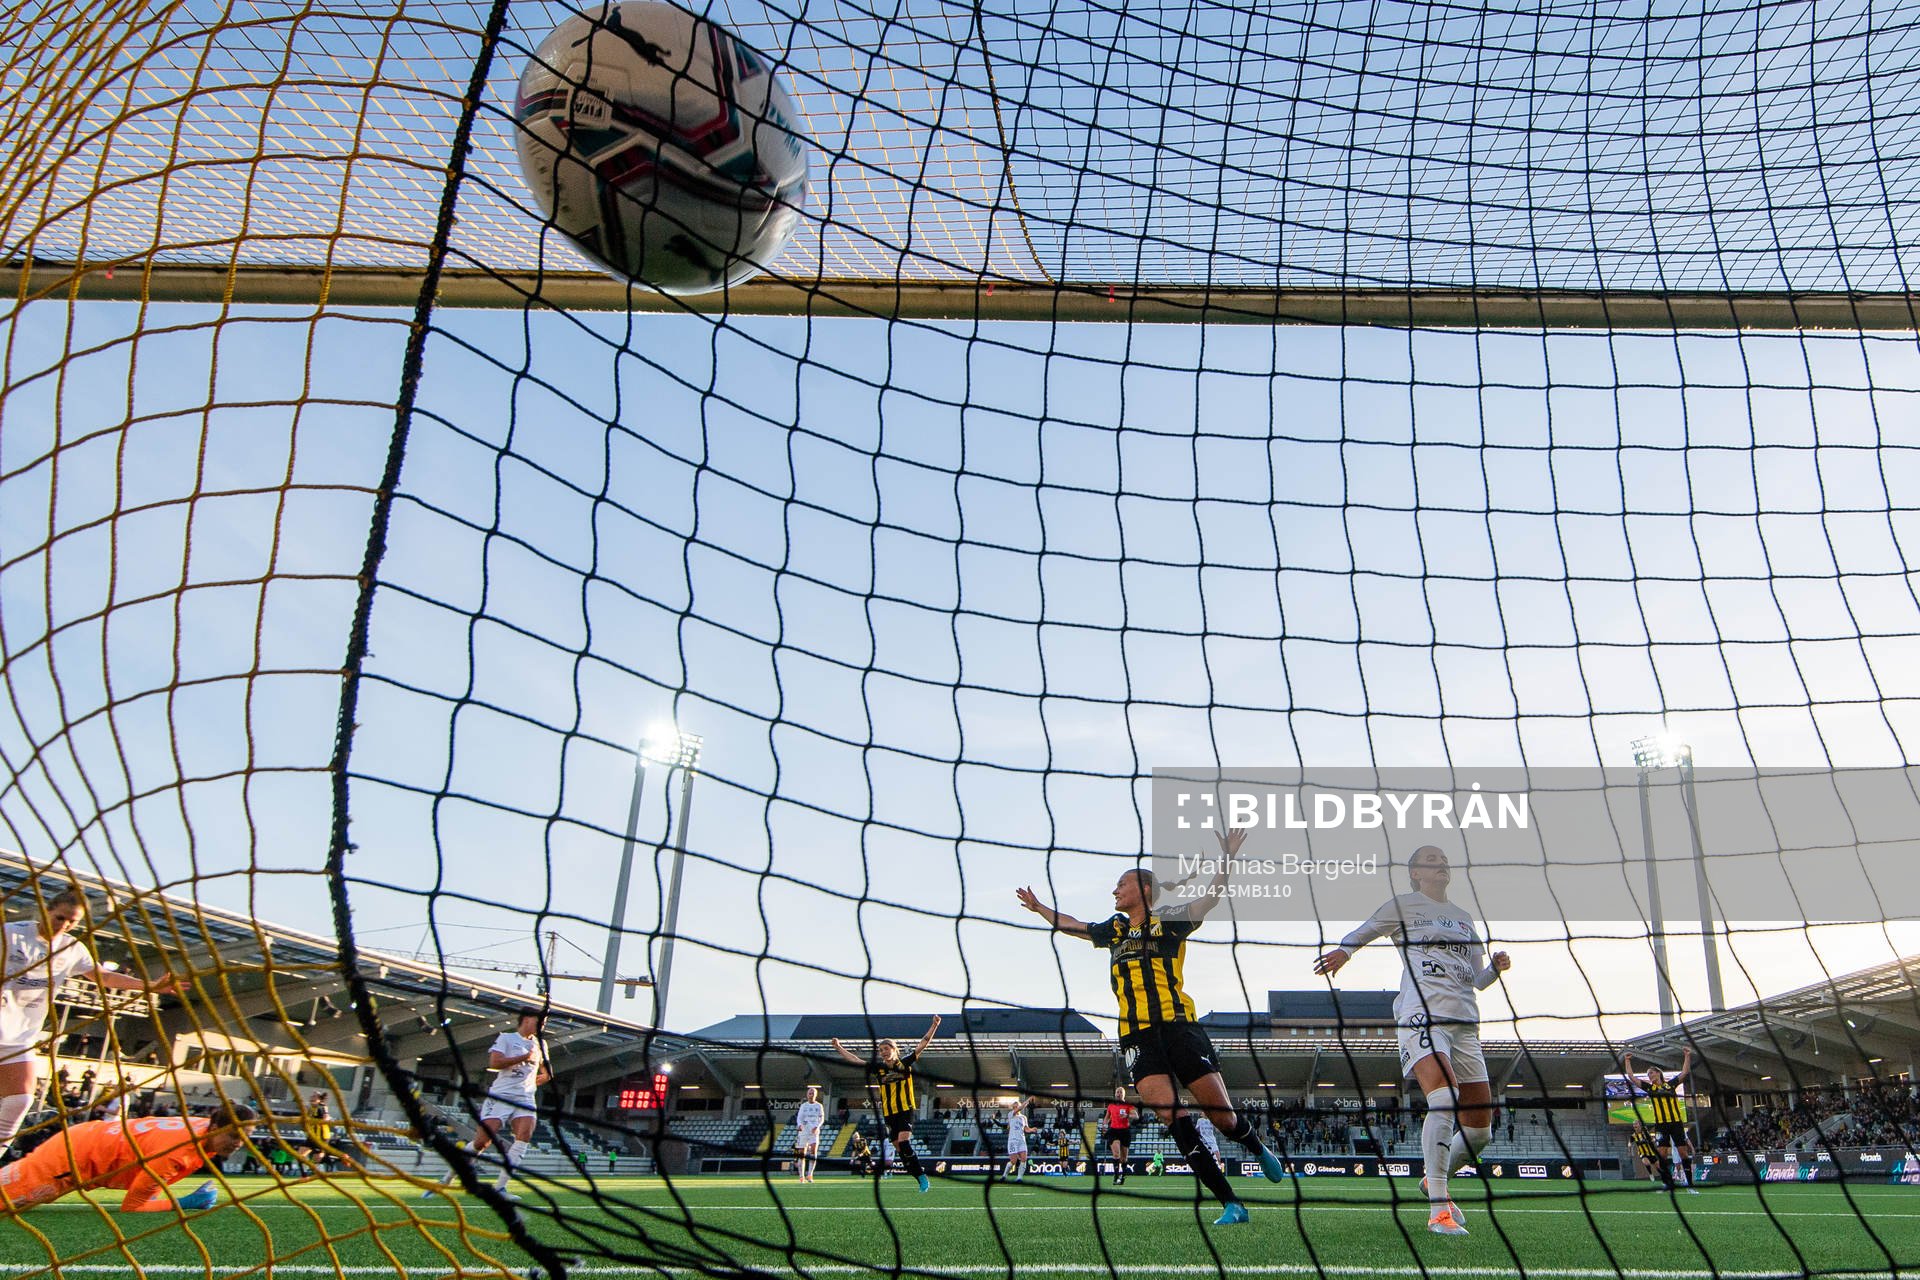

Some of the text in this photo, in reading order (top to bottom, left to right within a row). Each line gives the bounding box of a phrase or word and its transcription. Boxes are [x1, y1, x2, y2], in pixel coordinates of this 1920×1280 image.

[1419, 1030, 1432, 1049] 6
[774, 1099, 803, 1109] bravid
[1318, 1165, 1346, 1174] Göteborg
